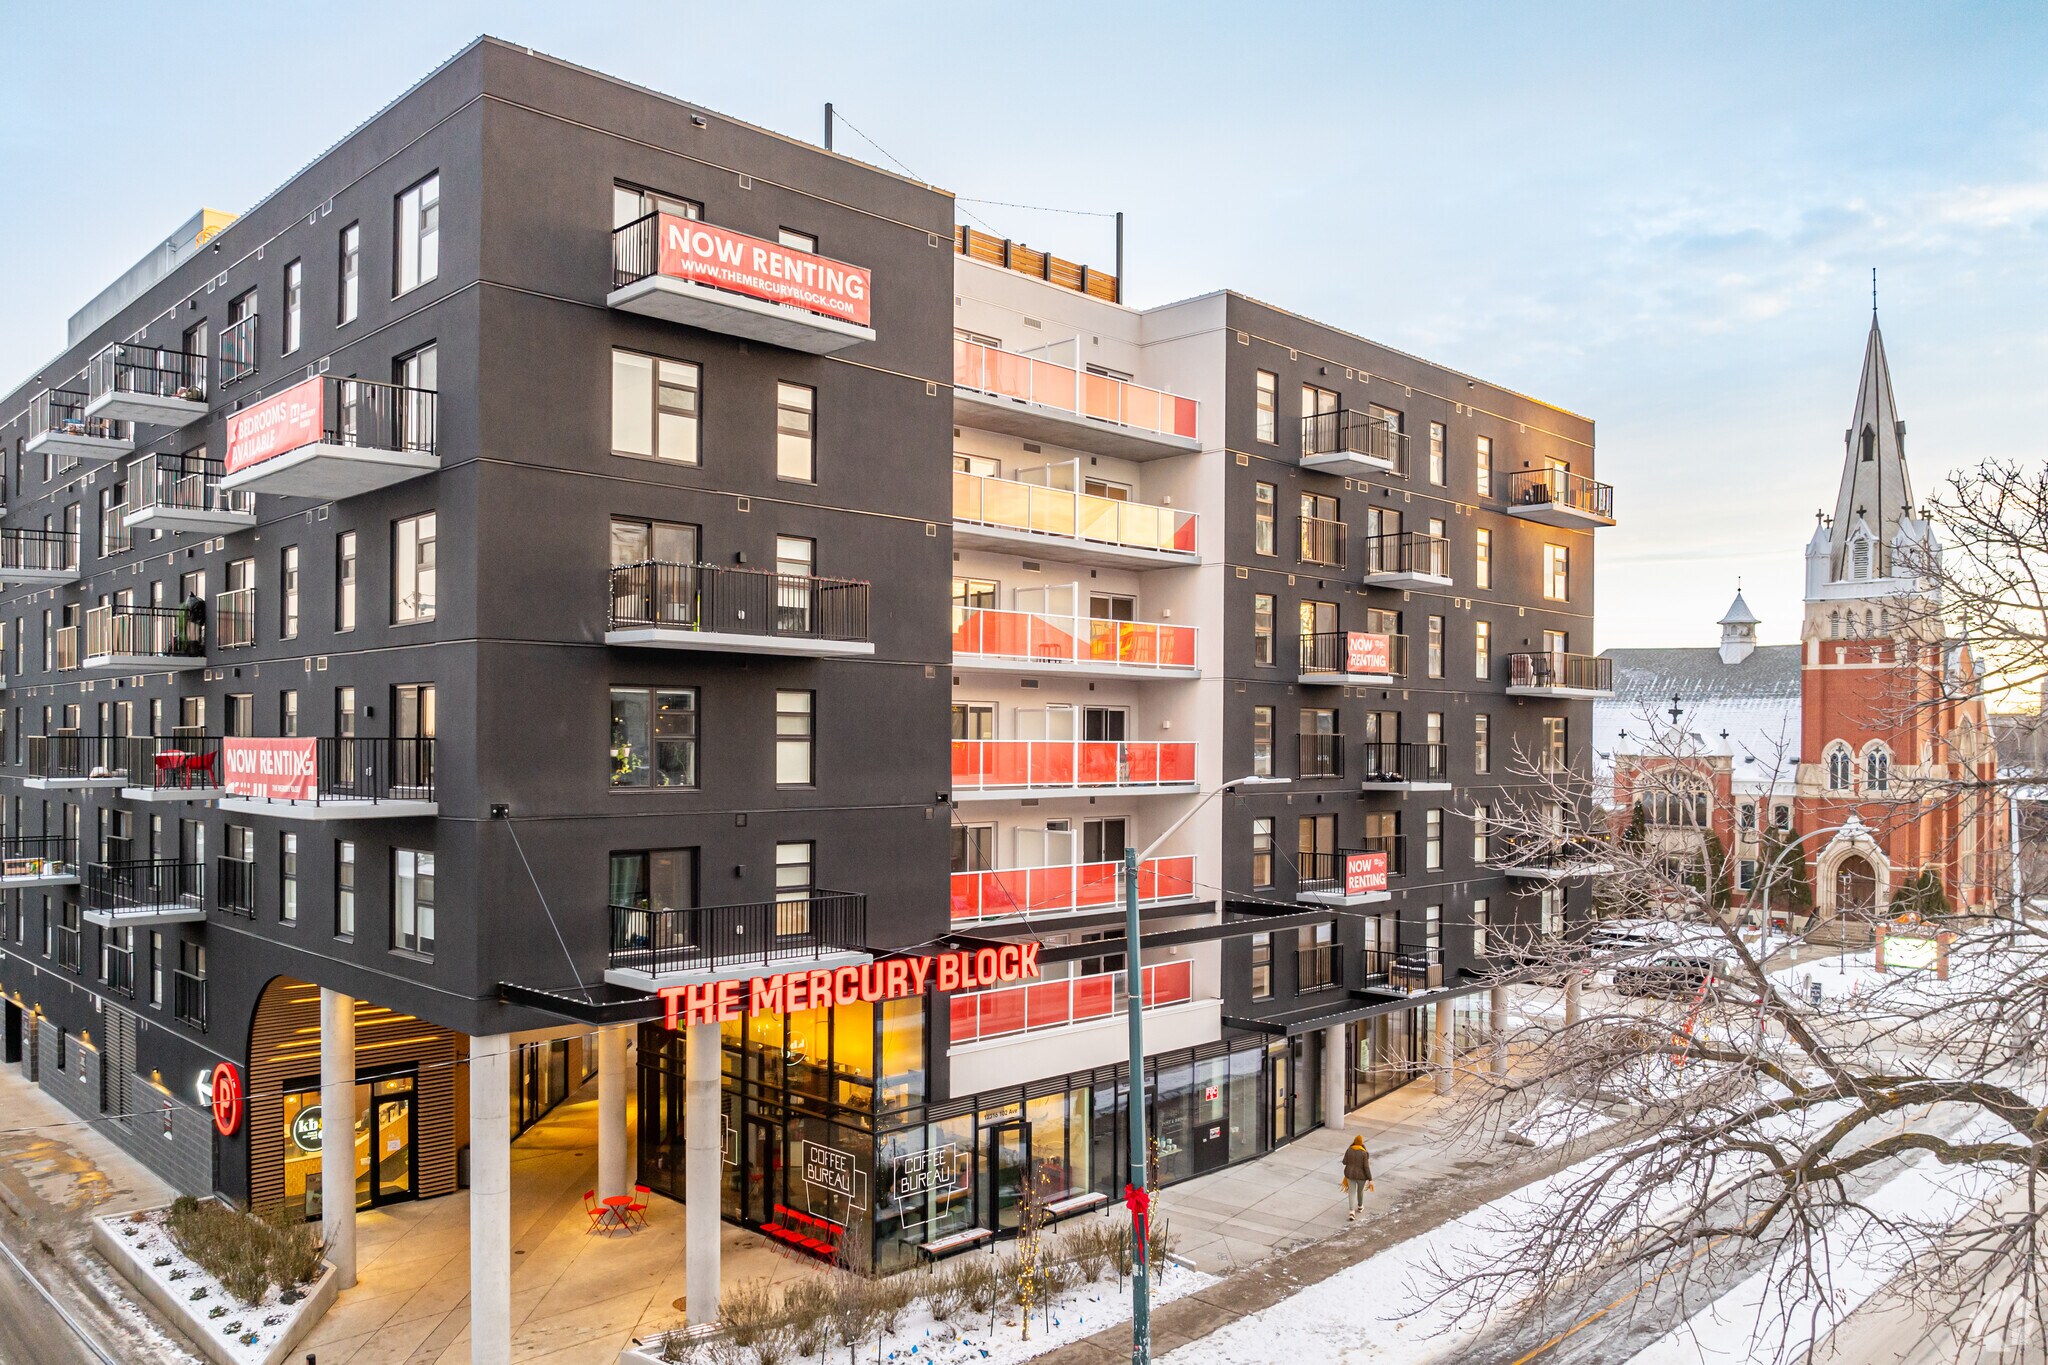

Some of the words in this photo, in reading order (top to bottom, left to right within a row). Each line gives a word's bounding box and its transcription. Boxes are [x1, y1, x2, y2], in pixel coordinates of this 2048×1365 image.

[669, 224, 743, 267] NOW
[753, 247, 864, 300] RENTING
[681, 259, 854, 314] WWW.THEMERCURYBLOCK.COM
[239, 401, 287, 440] BEDROOMS
[232, 429, 275, 465] AVAILABLE
[1350, 639, 1373, 652] NOW
[1350, 653, 1386, 667] RENTING
[227, 749, 257, 774] NOW
[260, 749, 314, 776] RENTING
[1348, 859, 1372, 874] NOW
[1348, 873, 1386, 889] RENTING
[658, 979, 741, 1030] THE
[748, 956, 932, 1018] MERCURY
[936, 941, 1040, 992] BLOCK
[219, 1077, 231, 1119] P
[810, 1146, 847, 1173] COFFEE
[904, 1149, 946, 1175] COFFEE
[807, 1163, 850, 1191] BUREAU
[901, 1166, 950, 1193] BUREAU
